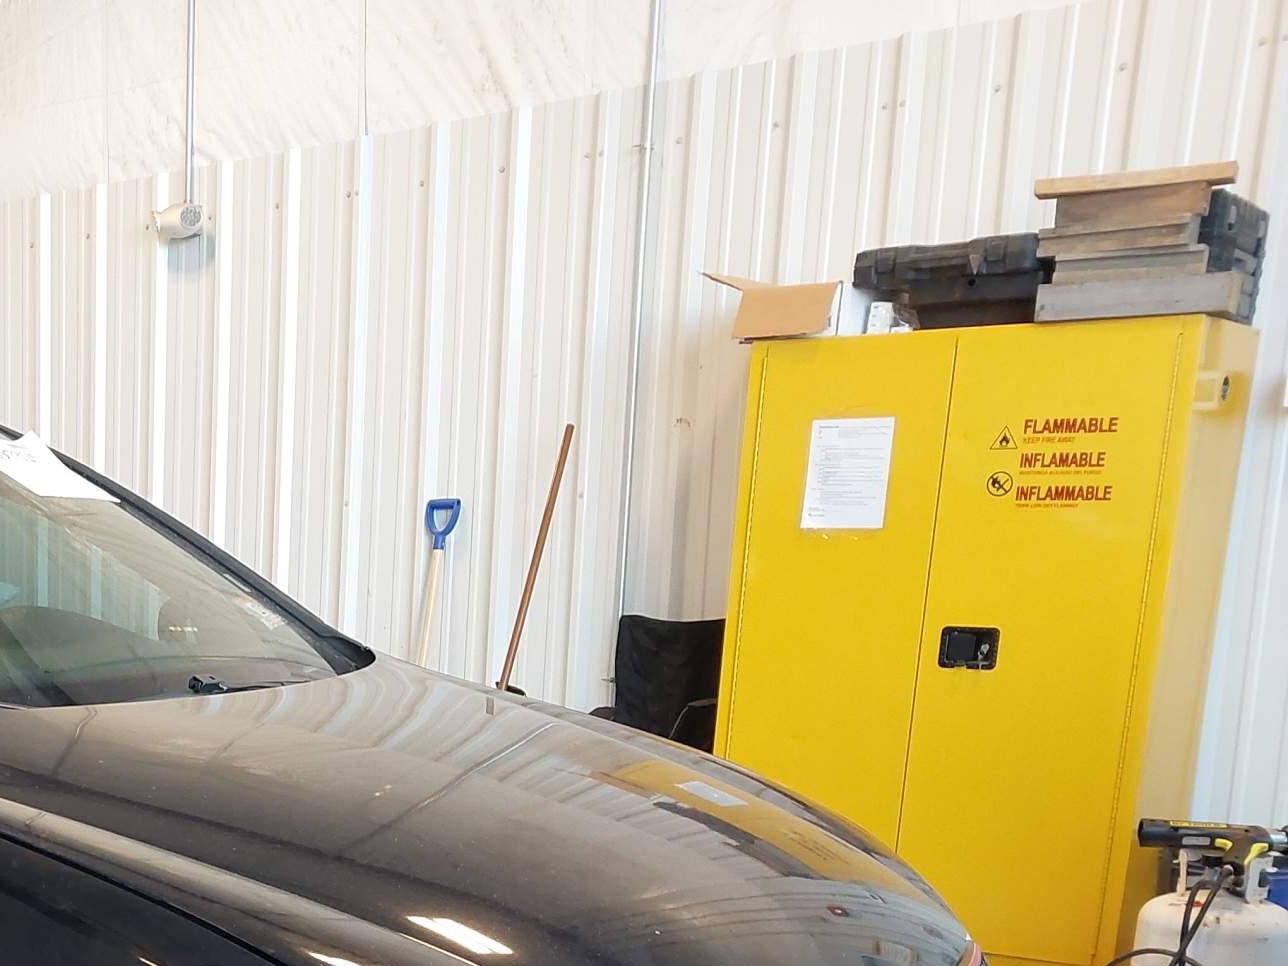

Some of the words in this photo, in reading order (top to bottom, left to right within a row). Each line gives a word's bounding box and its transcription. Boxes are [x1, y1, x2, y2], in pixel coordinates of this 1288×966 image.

[1023, 417, 1118, 434] FLAMMABLE
[1020, 452, 1106, 468] INFLAMABLE
[1015, 486, 1112, 501] INFLAMMABLE
